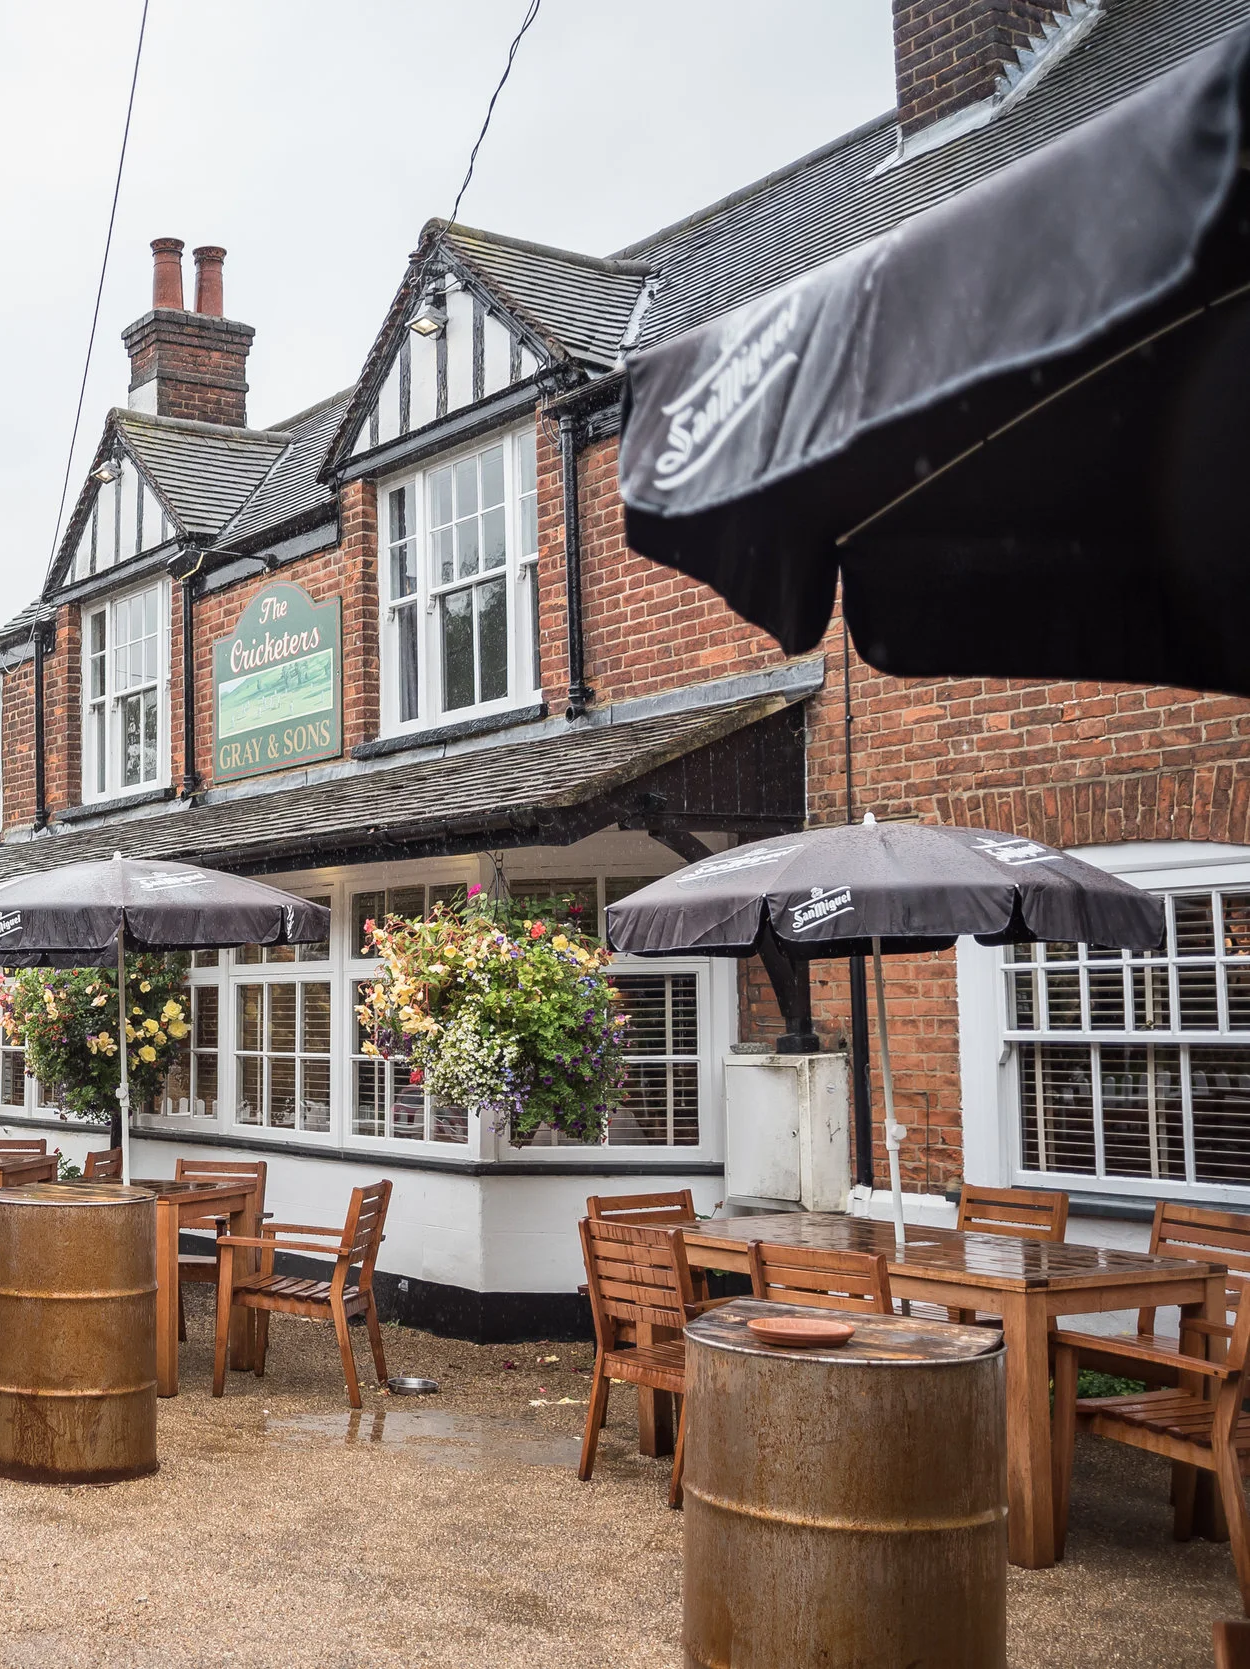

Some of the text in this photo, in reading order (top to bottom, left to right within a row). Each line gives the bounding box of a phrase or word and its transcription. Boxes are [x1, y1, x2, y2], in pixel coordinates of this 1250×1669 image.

[259, 596, 288, 625] The
[230, 627, 321, 674] Cricketers
[219, 719, 331, 771] GRAY & SONS
